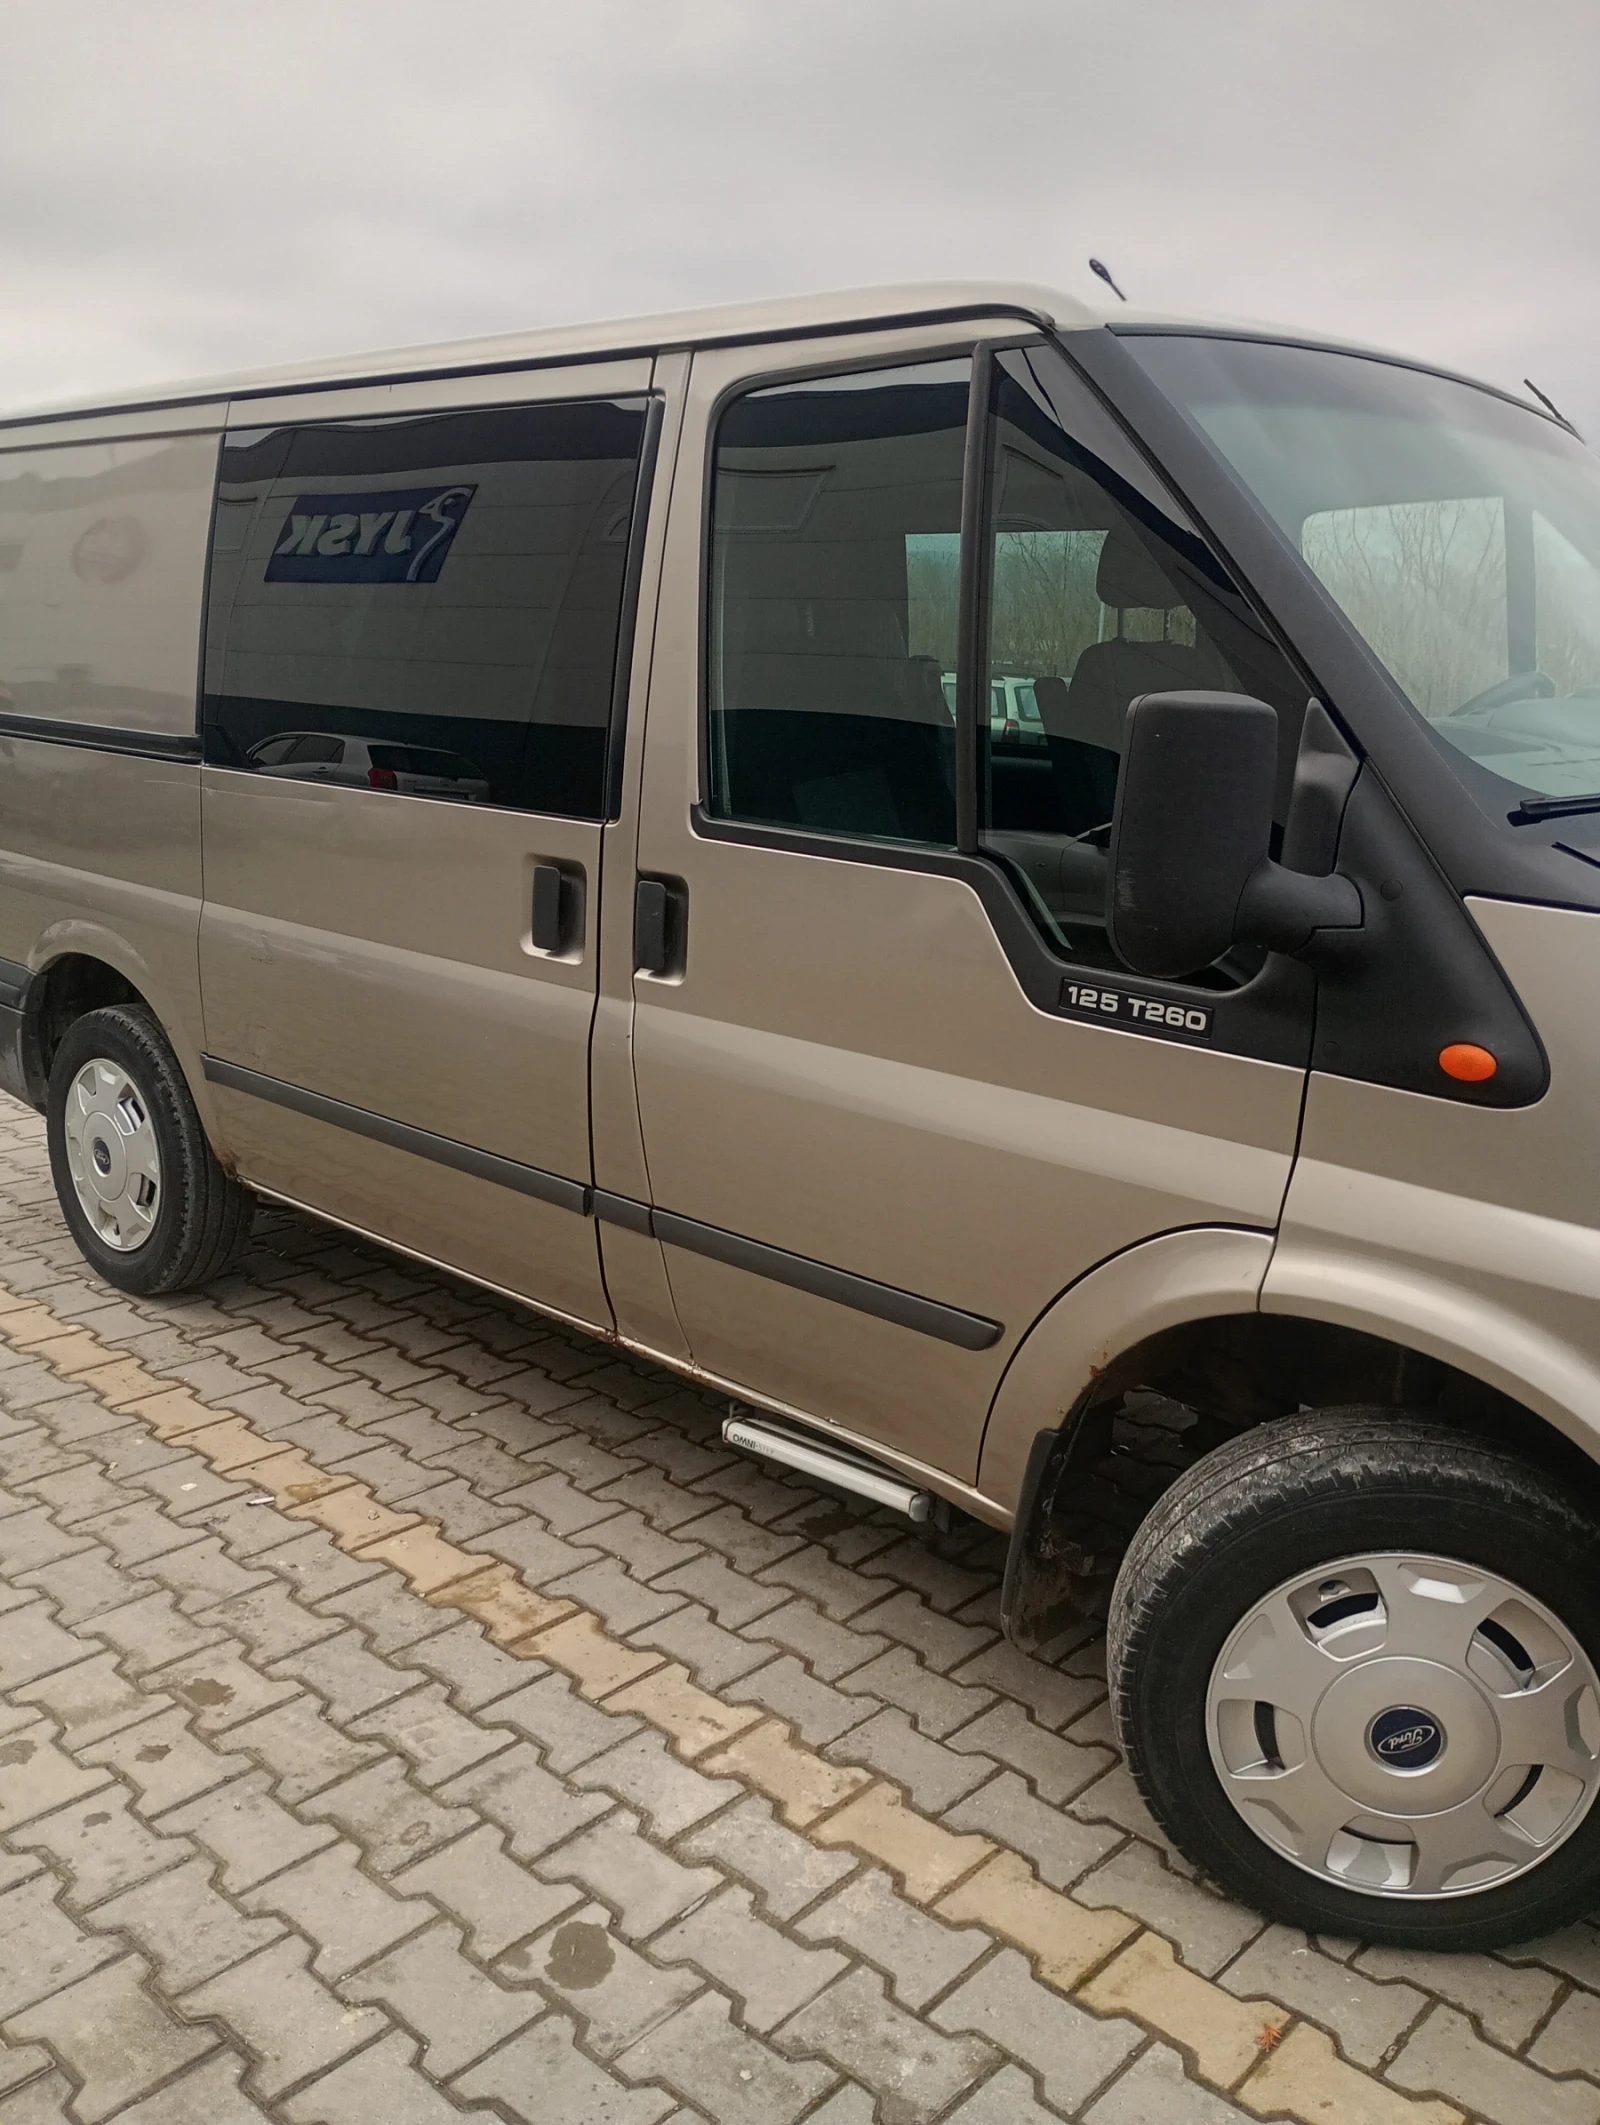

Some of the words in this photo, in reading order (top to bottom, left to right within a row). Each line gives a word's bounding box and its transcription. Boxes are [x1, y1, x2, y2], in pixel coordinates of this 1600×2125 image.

[1068, 986, 1118, 1013] 125
[1128, 997, 1206, 1031] T260
[1387, 1727, 1424, 1751] Ford
